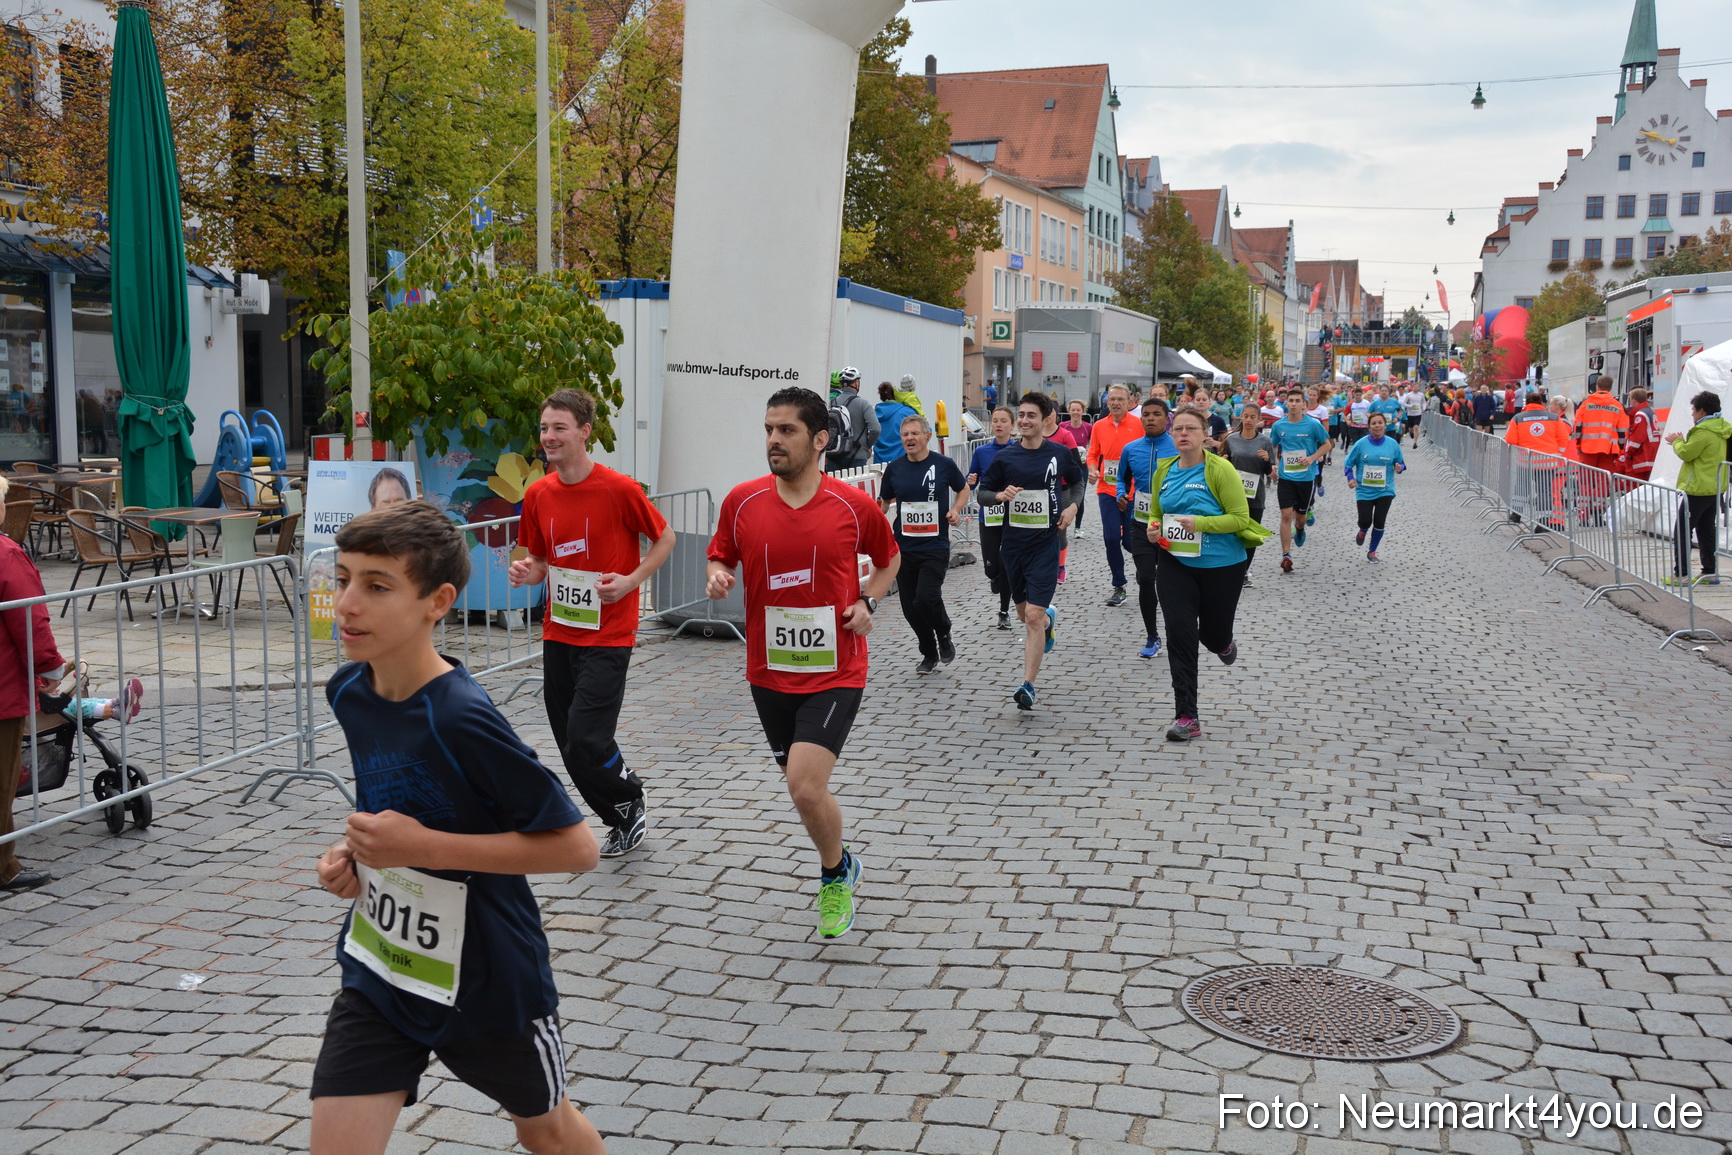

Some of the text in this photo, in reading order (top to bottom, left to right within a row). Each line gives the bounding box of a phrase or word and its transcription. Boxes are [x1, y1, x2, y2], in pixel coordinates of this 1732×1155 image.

[667, 361, 800, 380] www.bmw-laufsport.de
[1588, 404, 1619, 412] NOTARZT
[1286, 456, 1302, 465] 524
[1365, 471, 1383, 479] 5125
[1014, 501, 1043, 514] 5248
[314, 512, 354, 523] WEITER
[906, 512, 933, 523] 8013
[781, 575, 800, 584] DEHN
[557, 584, 592, 606] 5154
[563, 608, 580, 618] Martin
[775, 626, 825, 648] 5102
[791, 653, 809, 662] Saad
[367, 881, 440, 950] 5015
